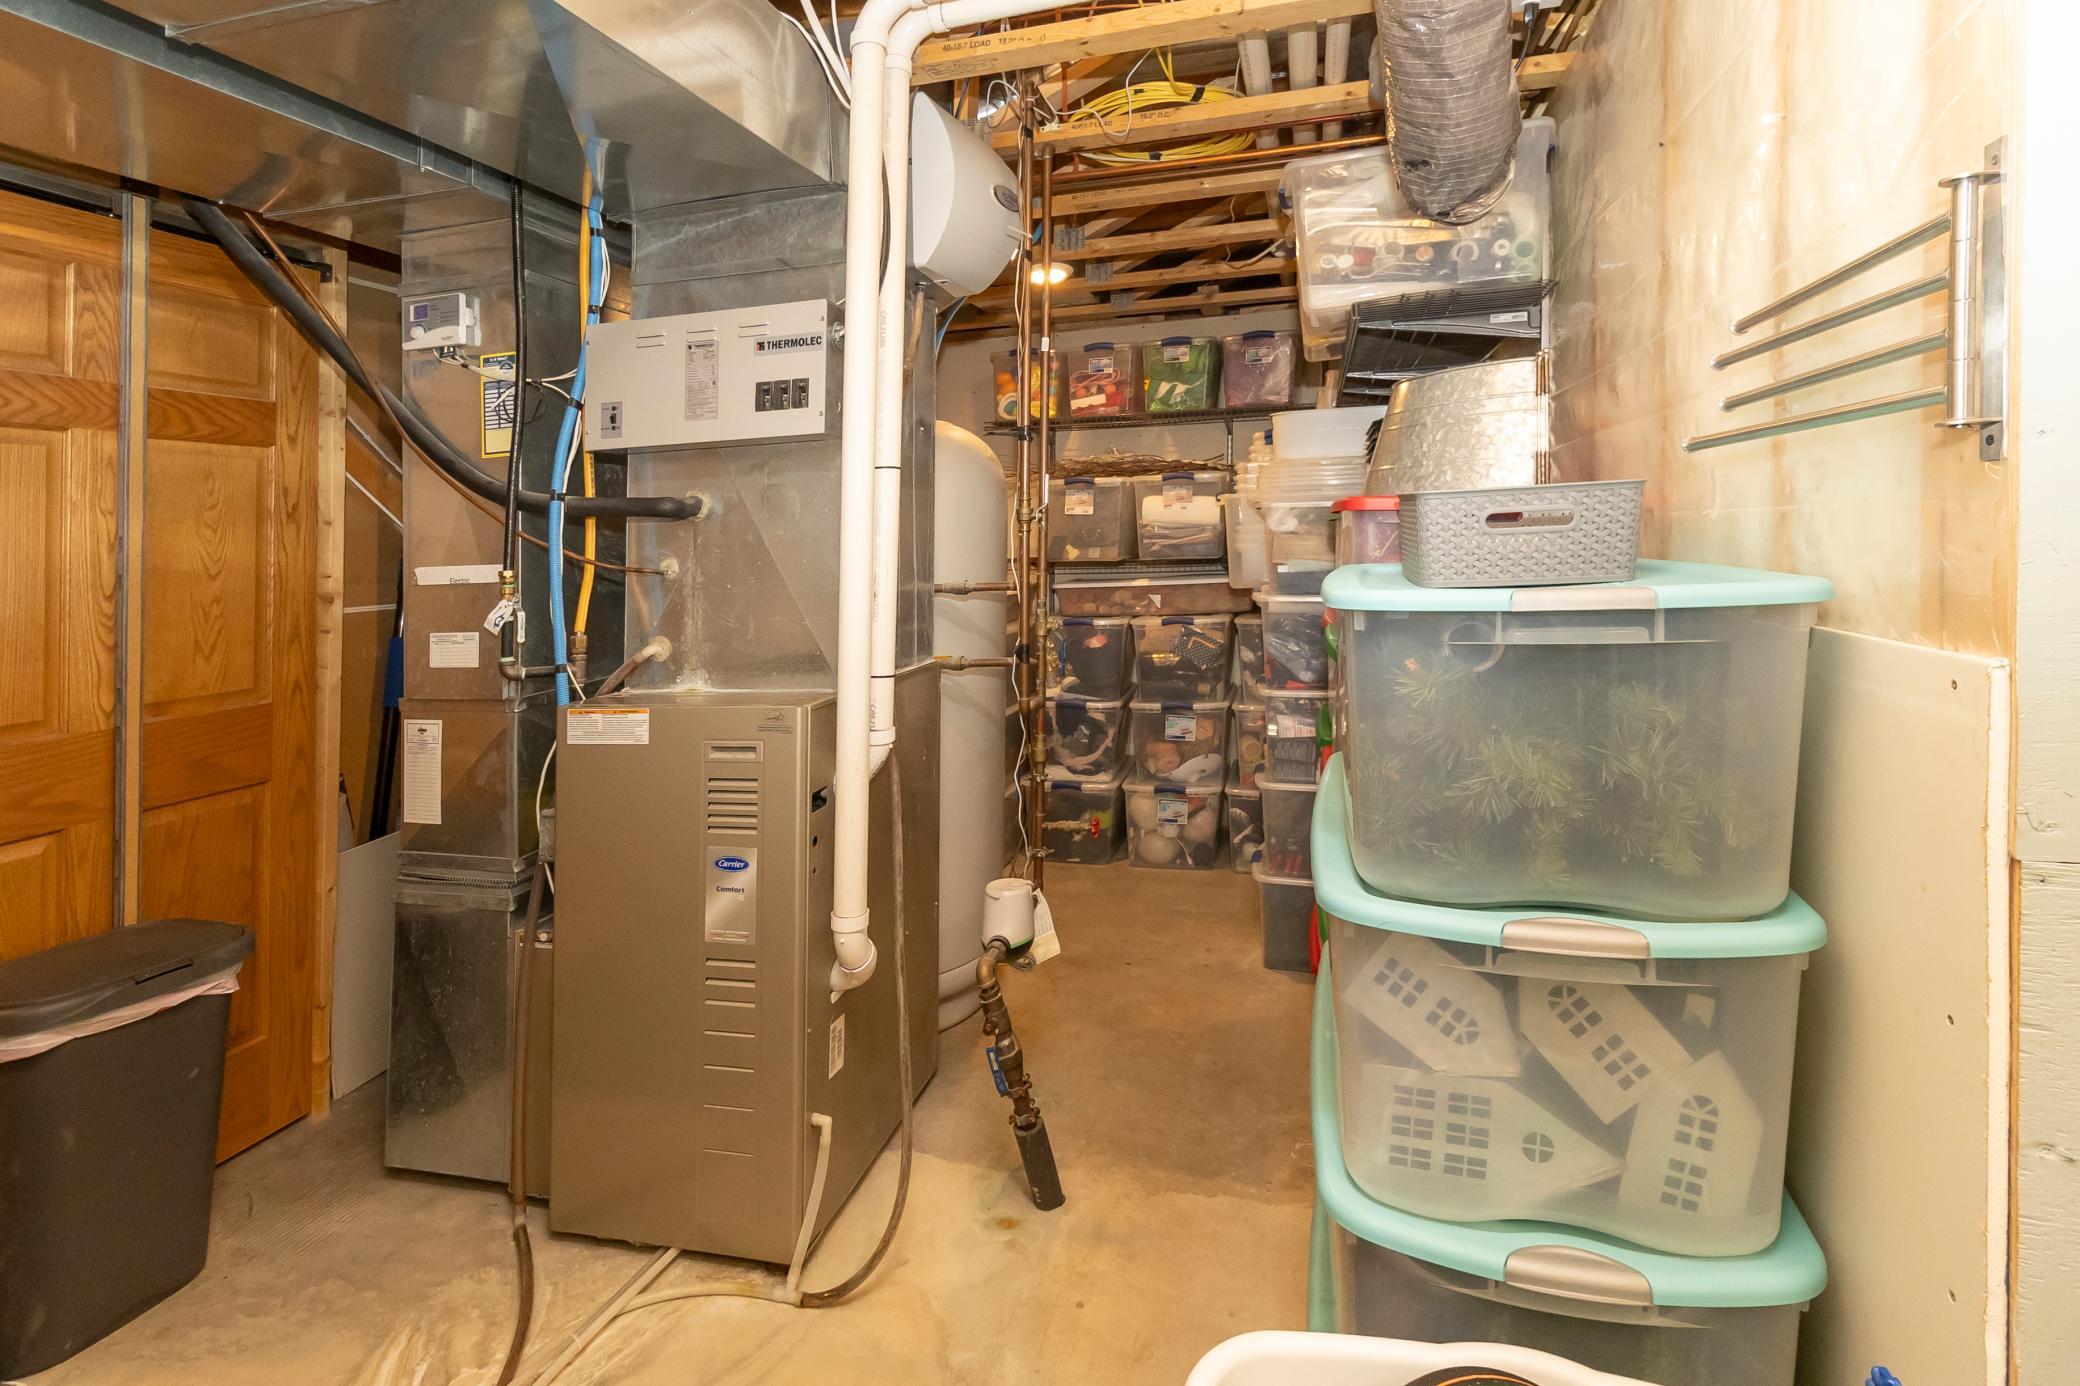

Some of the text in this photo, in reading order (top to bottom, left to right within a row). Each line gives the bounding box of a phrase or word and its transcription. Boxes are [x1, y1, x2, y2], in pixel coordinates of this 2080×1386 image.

[970, 40, 991, 49] LOAD
[767, 336, 822, 350] THERMOLEC
[718, 860, 746, 868] Carrier
